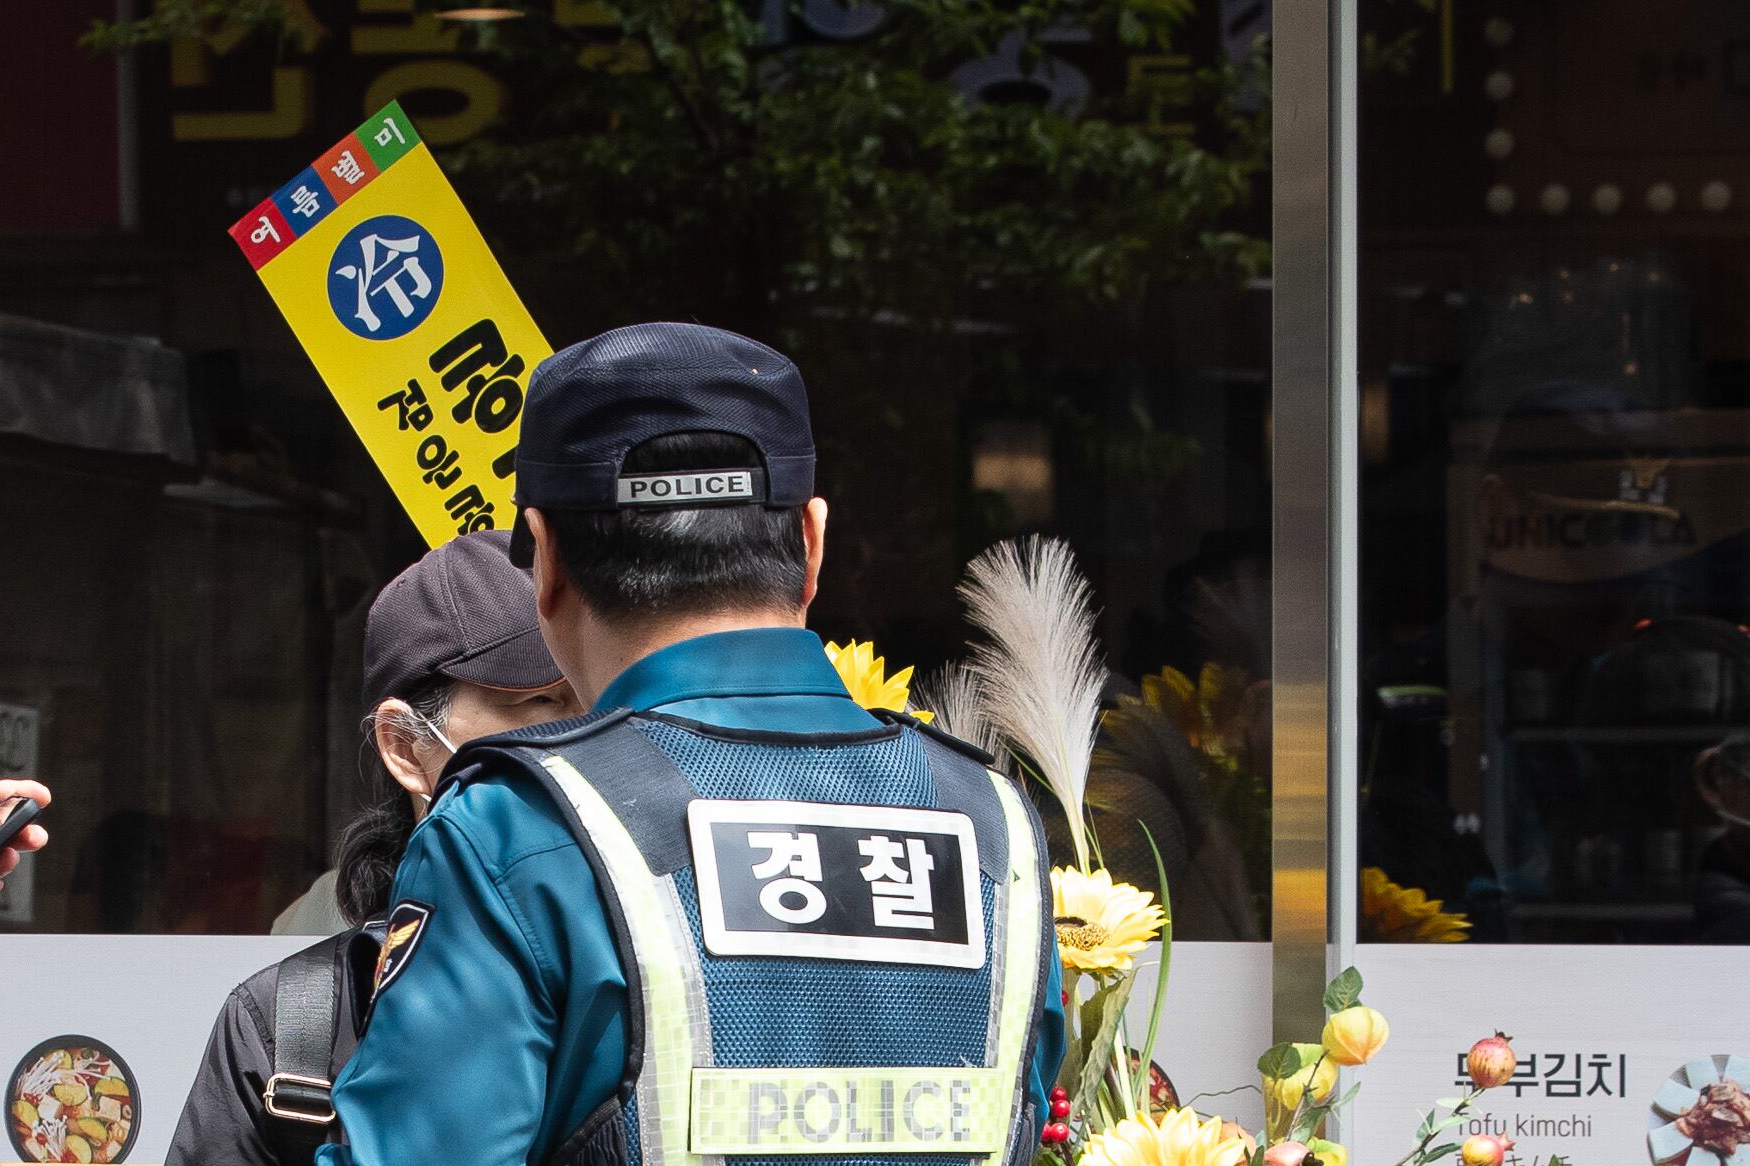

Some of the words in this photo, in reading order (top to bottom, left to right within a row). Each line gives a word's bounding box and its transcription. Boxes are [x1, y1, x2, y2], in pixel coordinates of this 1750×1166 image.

[250, 117, 406, 244] 여름별미
[335, 233, 432, 332] 冷
[630, 475, 744, 499] POLICE
[746, 830, 935, 930] 경찰
[748, 1079, 971, 1145] POLICE
[1516, 1113, 1592, 1138] kimchi
